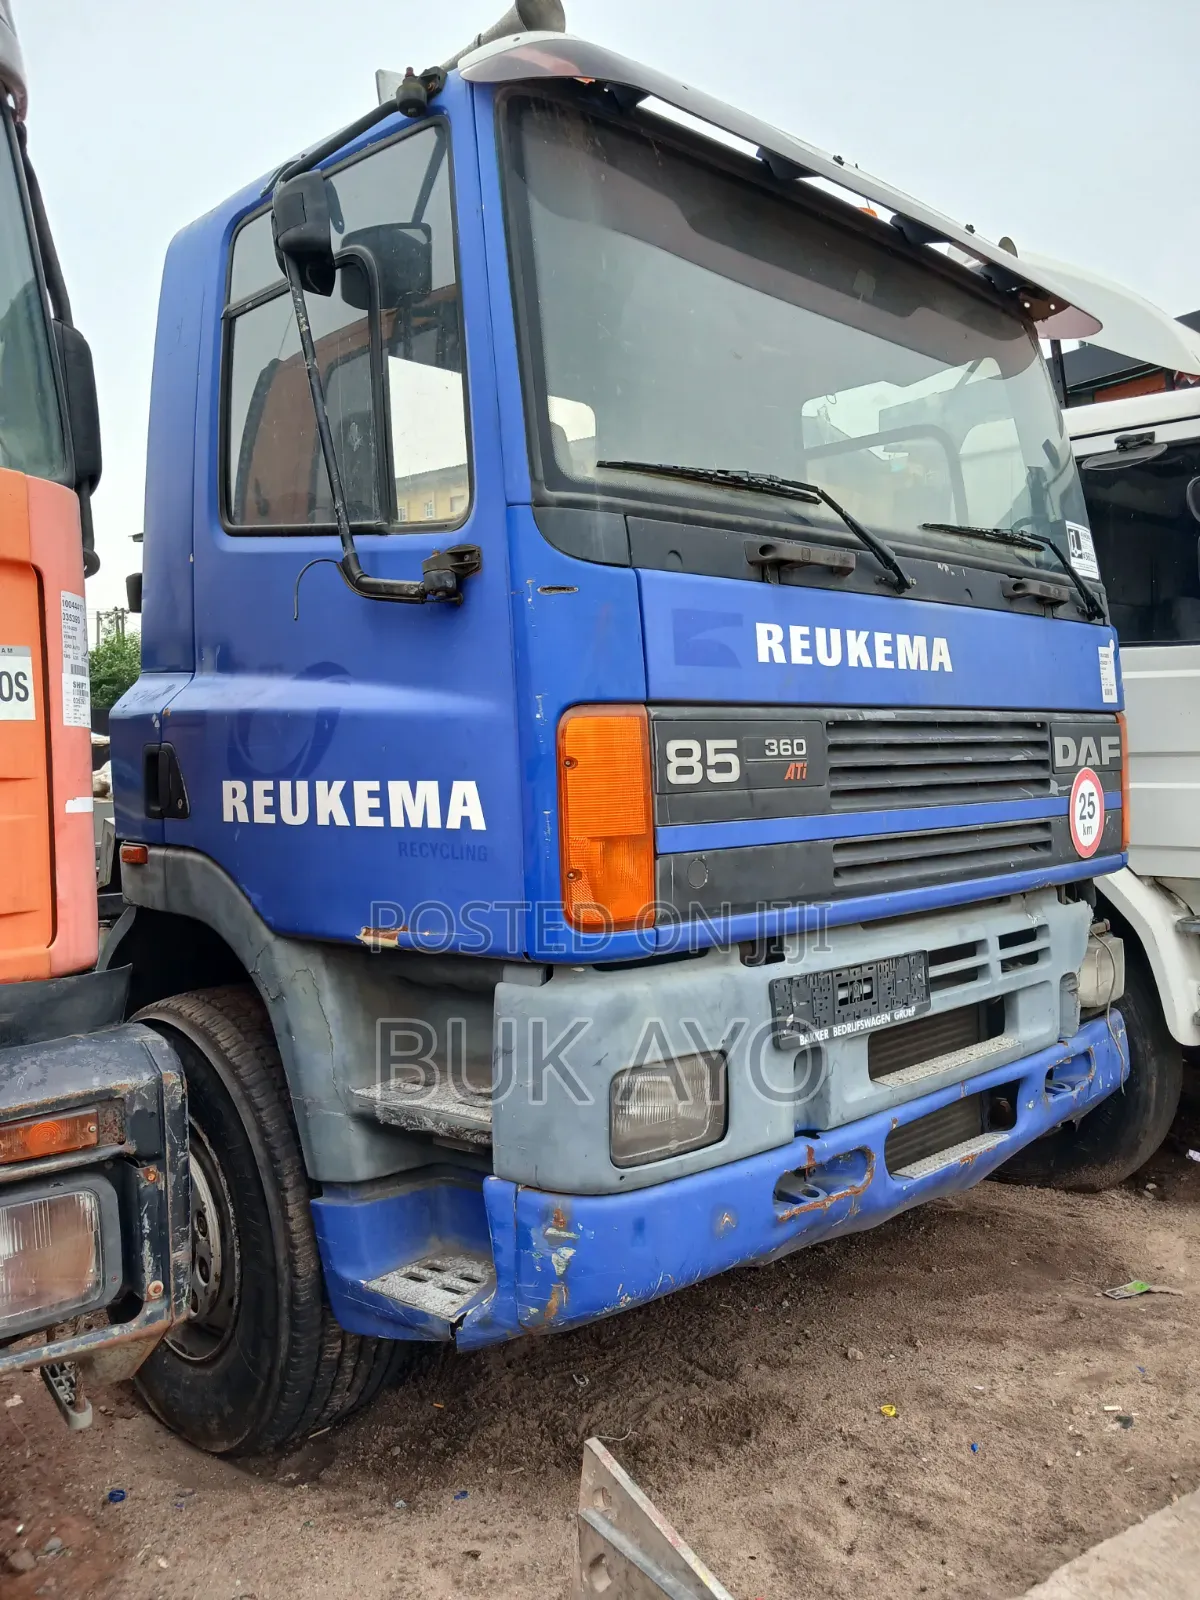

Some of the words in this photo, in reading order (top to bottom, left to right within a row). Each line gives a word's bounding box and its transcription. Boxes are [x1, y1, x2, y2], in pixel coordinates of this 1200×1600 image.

[755, 622, 953, 672] REUKEMA
[666, 739, 741, 785] 85
[764, 738, 807, 756] 360
[1053, 736, 1120, 768] DAF
[222, 780, 487, 831] REUKEMA
[1078, 792, 1096, 821] 25
[1082, 823, 1093, 836] km
[398, 841, 488, 862] RECYCLING
[799, 1028, 830, 1046] BAKKER
[832, 1013, 892, 1036] BEDRIJFSWAGEN
